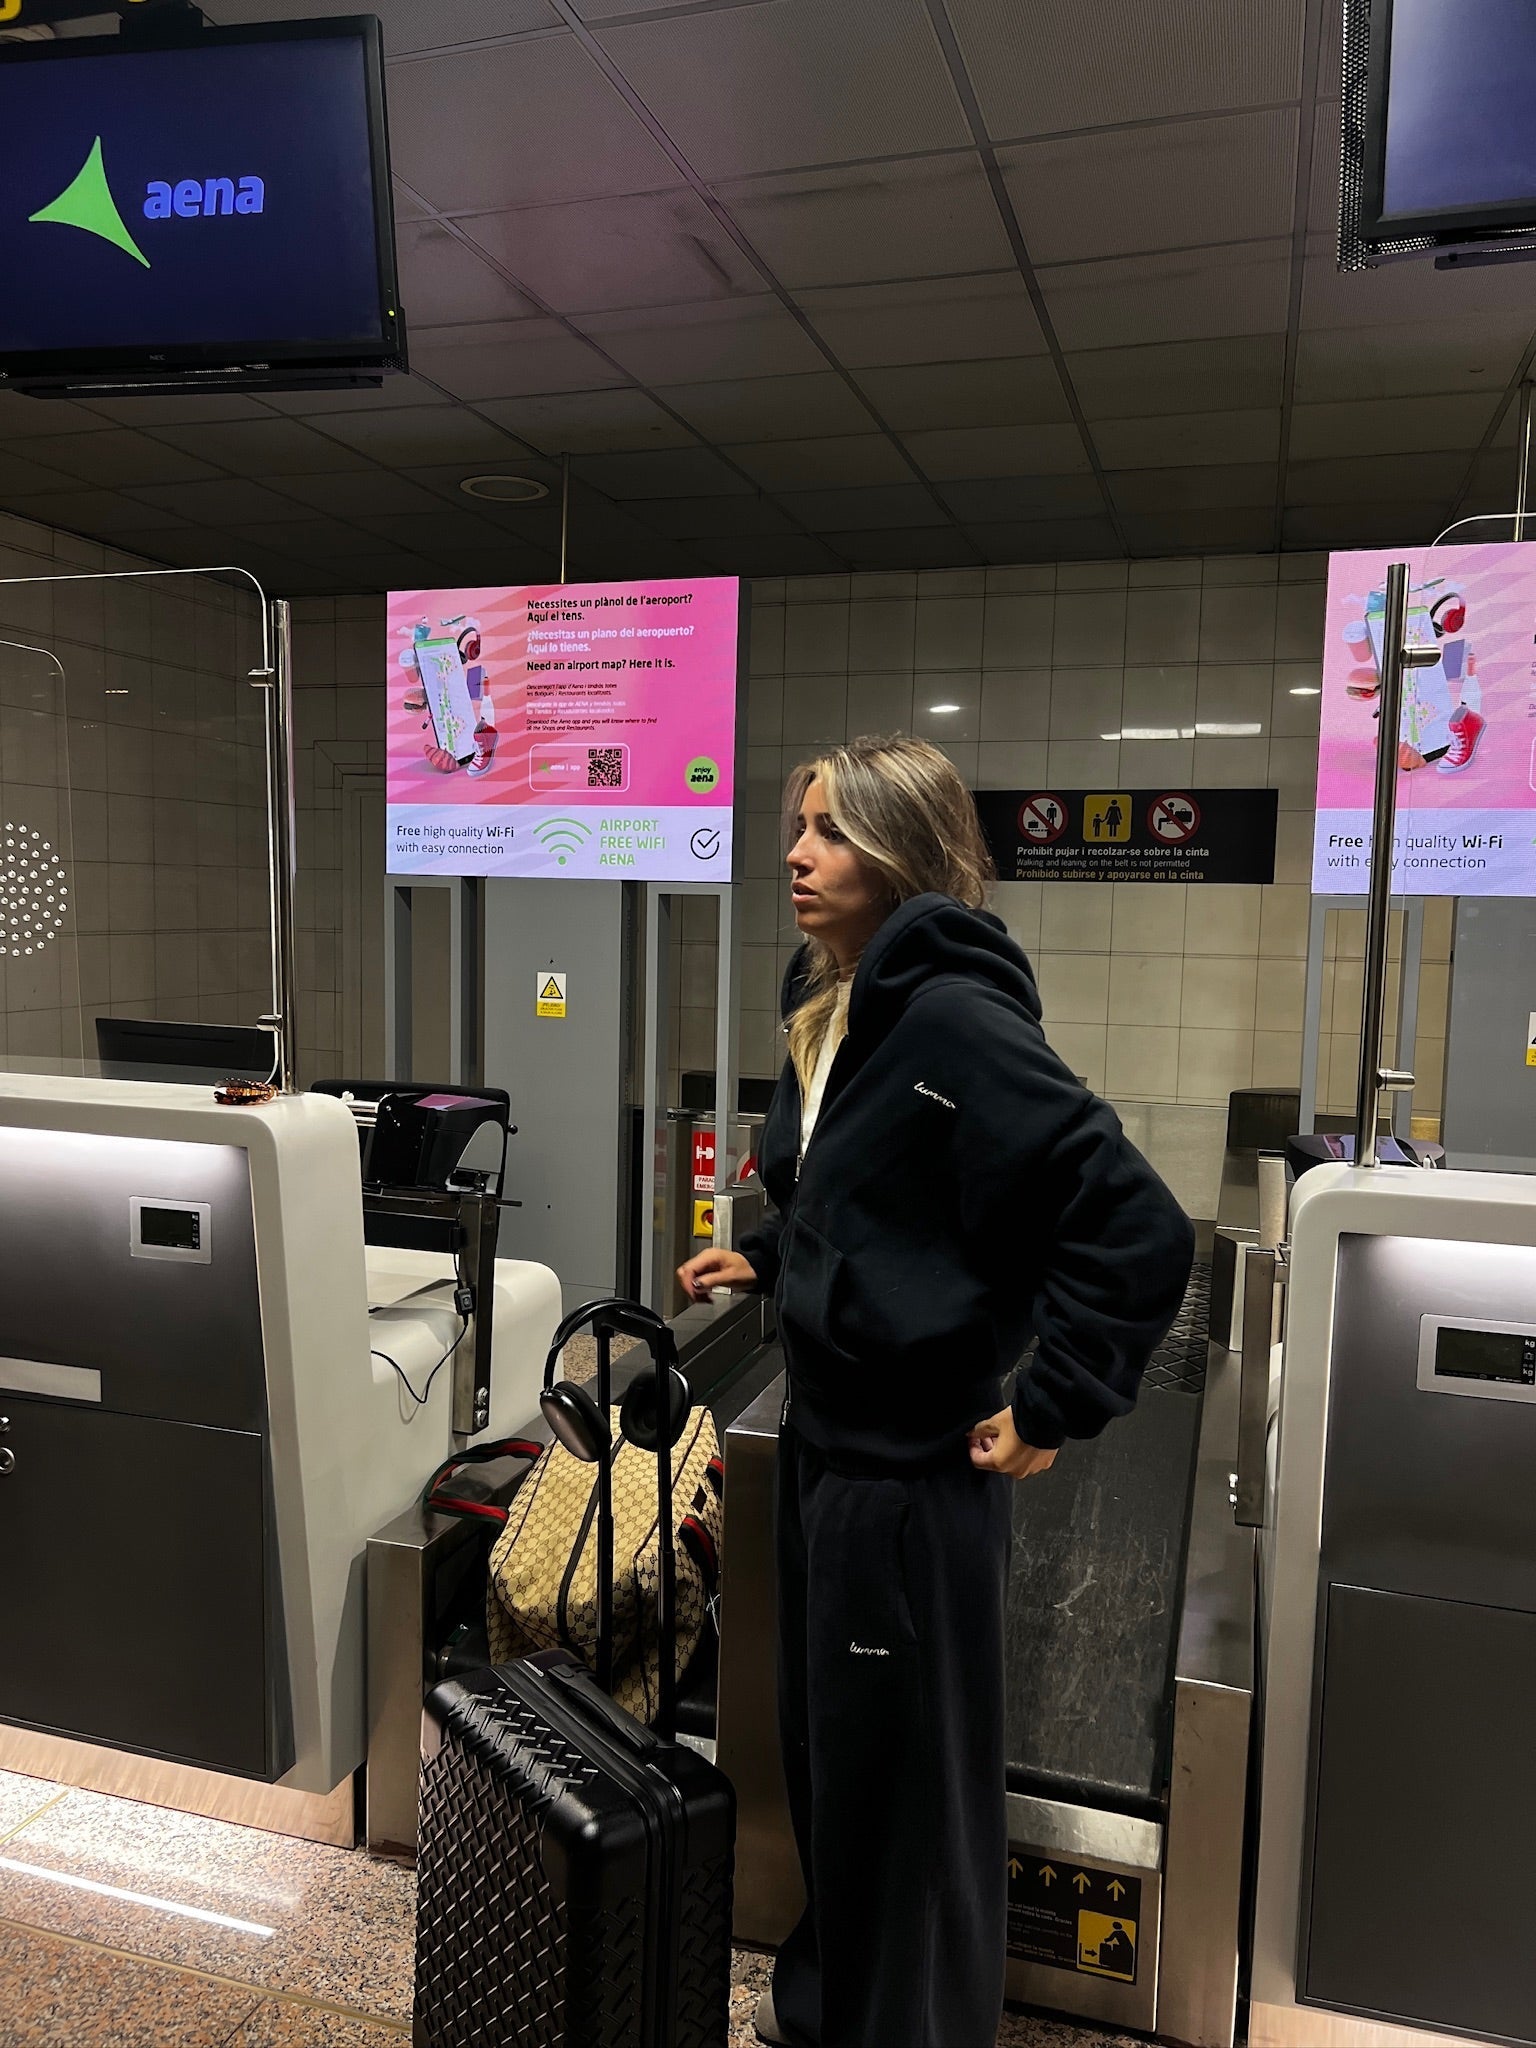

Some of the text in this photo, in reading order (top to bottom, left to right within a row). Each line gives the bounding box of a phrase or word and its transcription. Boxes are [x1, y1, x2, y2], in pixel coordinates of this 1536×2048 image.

[143, 175, 265, 220] aena
[528, 599, 578, 609] Necessites
[594, 597, 624, 609] plànol
[626, 596, 638, 606] de
[640, 594, 693, 606] l'aeroport?
[527, 611, 585, 623] Aquí el tens.
[527, 629, 575, 642] ¿Necesitas
[592, 628, 617, 640] plano
[620, 628, 634, 637] del
[637, 625, 695, 638] aeropuerto?
[527, 641, 591, 655] Aquí lo tienes.
[527, 658, 675, 671] Need an airport map? Here it is.
[694, 766, 712, 774] enjoy
[690, 774, 714, 783] aena
[397, 825, 514, 839] Free high quality Wi-Fi
[600, 820, 659, 832] AIRPORT
[396, 842, 504, 855] with easy connection
[600, 836, 666, 849] FREE WIFI
[1329, 835, 1363, 847] Free
[1405, 835, 1457, 851] quality
[1462, 835, 1503, 848] Wi-Fi
[1017, 846, 1210, 857] Prohibit pujar i recolzar-se sobre la cinta
[600, 853, 635, 865] AENA
[1016, 858, 1044, 868] Walking
[1046, 859, 1059, 867] and
[1061, 859, 1087, 868] leaning
[1100, 859, 1112, 867] the
[1114, 859, 1129, 867] belt
[1154, 860, 1190, 868] permitted
[1328, 854, 1486, 870] with ey connection
[1016, 869, 1204, 880] Prohibido subirse y apoyarse en la cinta
[1524, 1339, 1536, 1348] kg
[1522, 1368, 1534, 1377] kg
